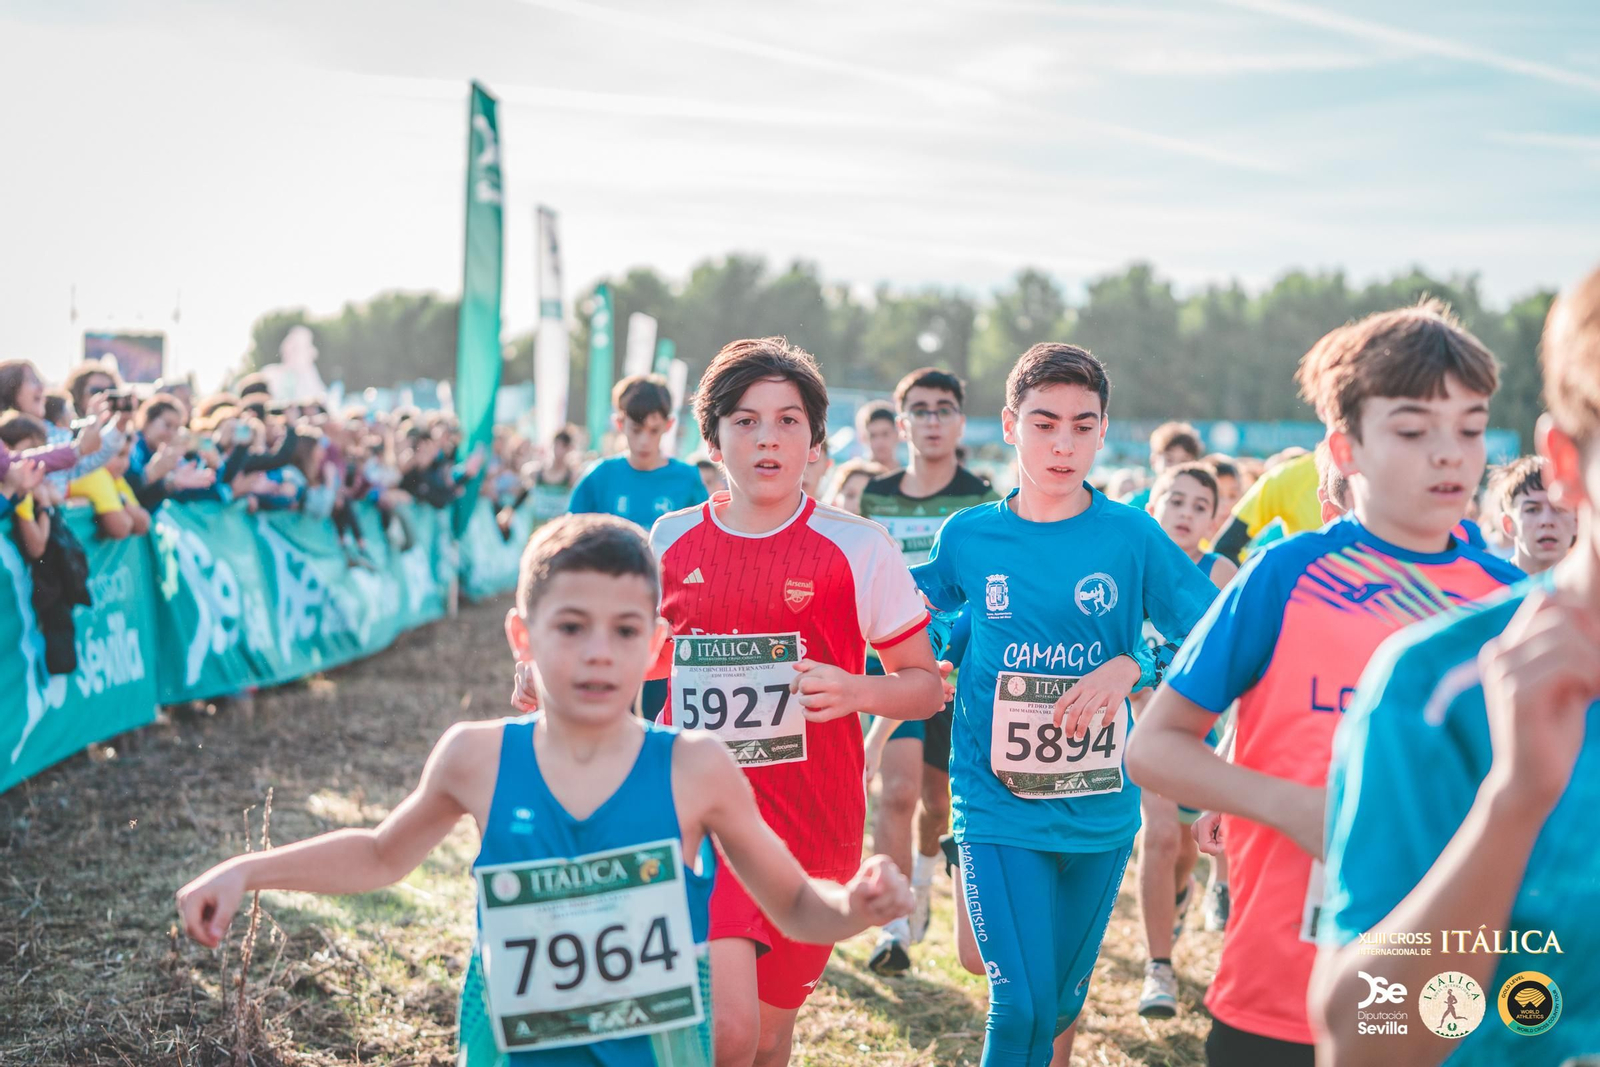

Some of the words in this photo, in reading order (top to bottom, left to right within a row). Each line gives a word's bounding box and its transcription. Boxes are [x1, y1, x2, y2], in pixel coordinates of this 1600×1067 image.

[786, 579, 812, 589] Arsenal
[698, 639, 761, 657] ITÁLICA
[682, 683, 791, 731] 5927
[1005, 721, 1116, 764] 5894
[966, 883, 989, 943] ATLETISMO
[504, 916, 679, 997] 7964
